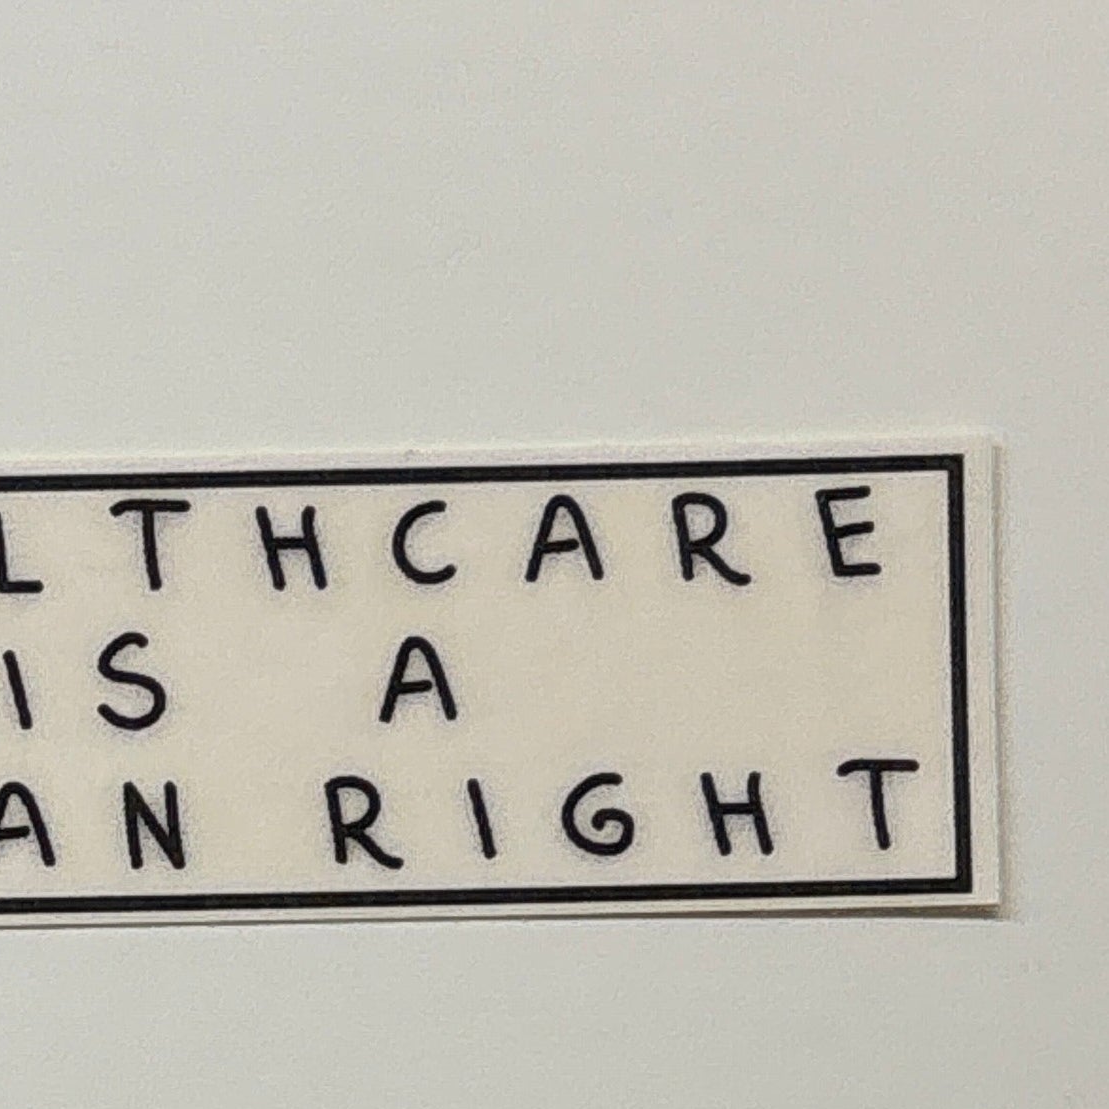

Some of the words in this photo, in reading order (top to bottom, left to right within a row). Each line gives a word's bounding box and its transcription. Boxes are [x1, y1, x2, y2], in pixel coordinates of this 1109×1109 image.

[1, 631, 168, 731] IS
[377, 635, 459, 725] A
[323, 757, 921, 871] RIGHT
